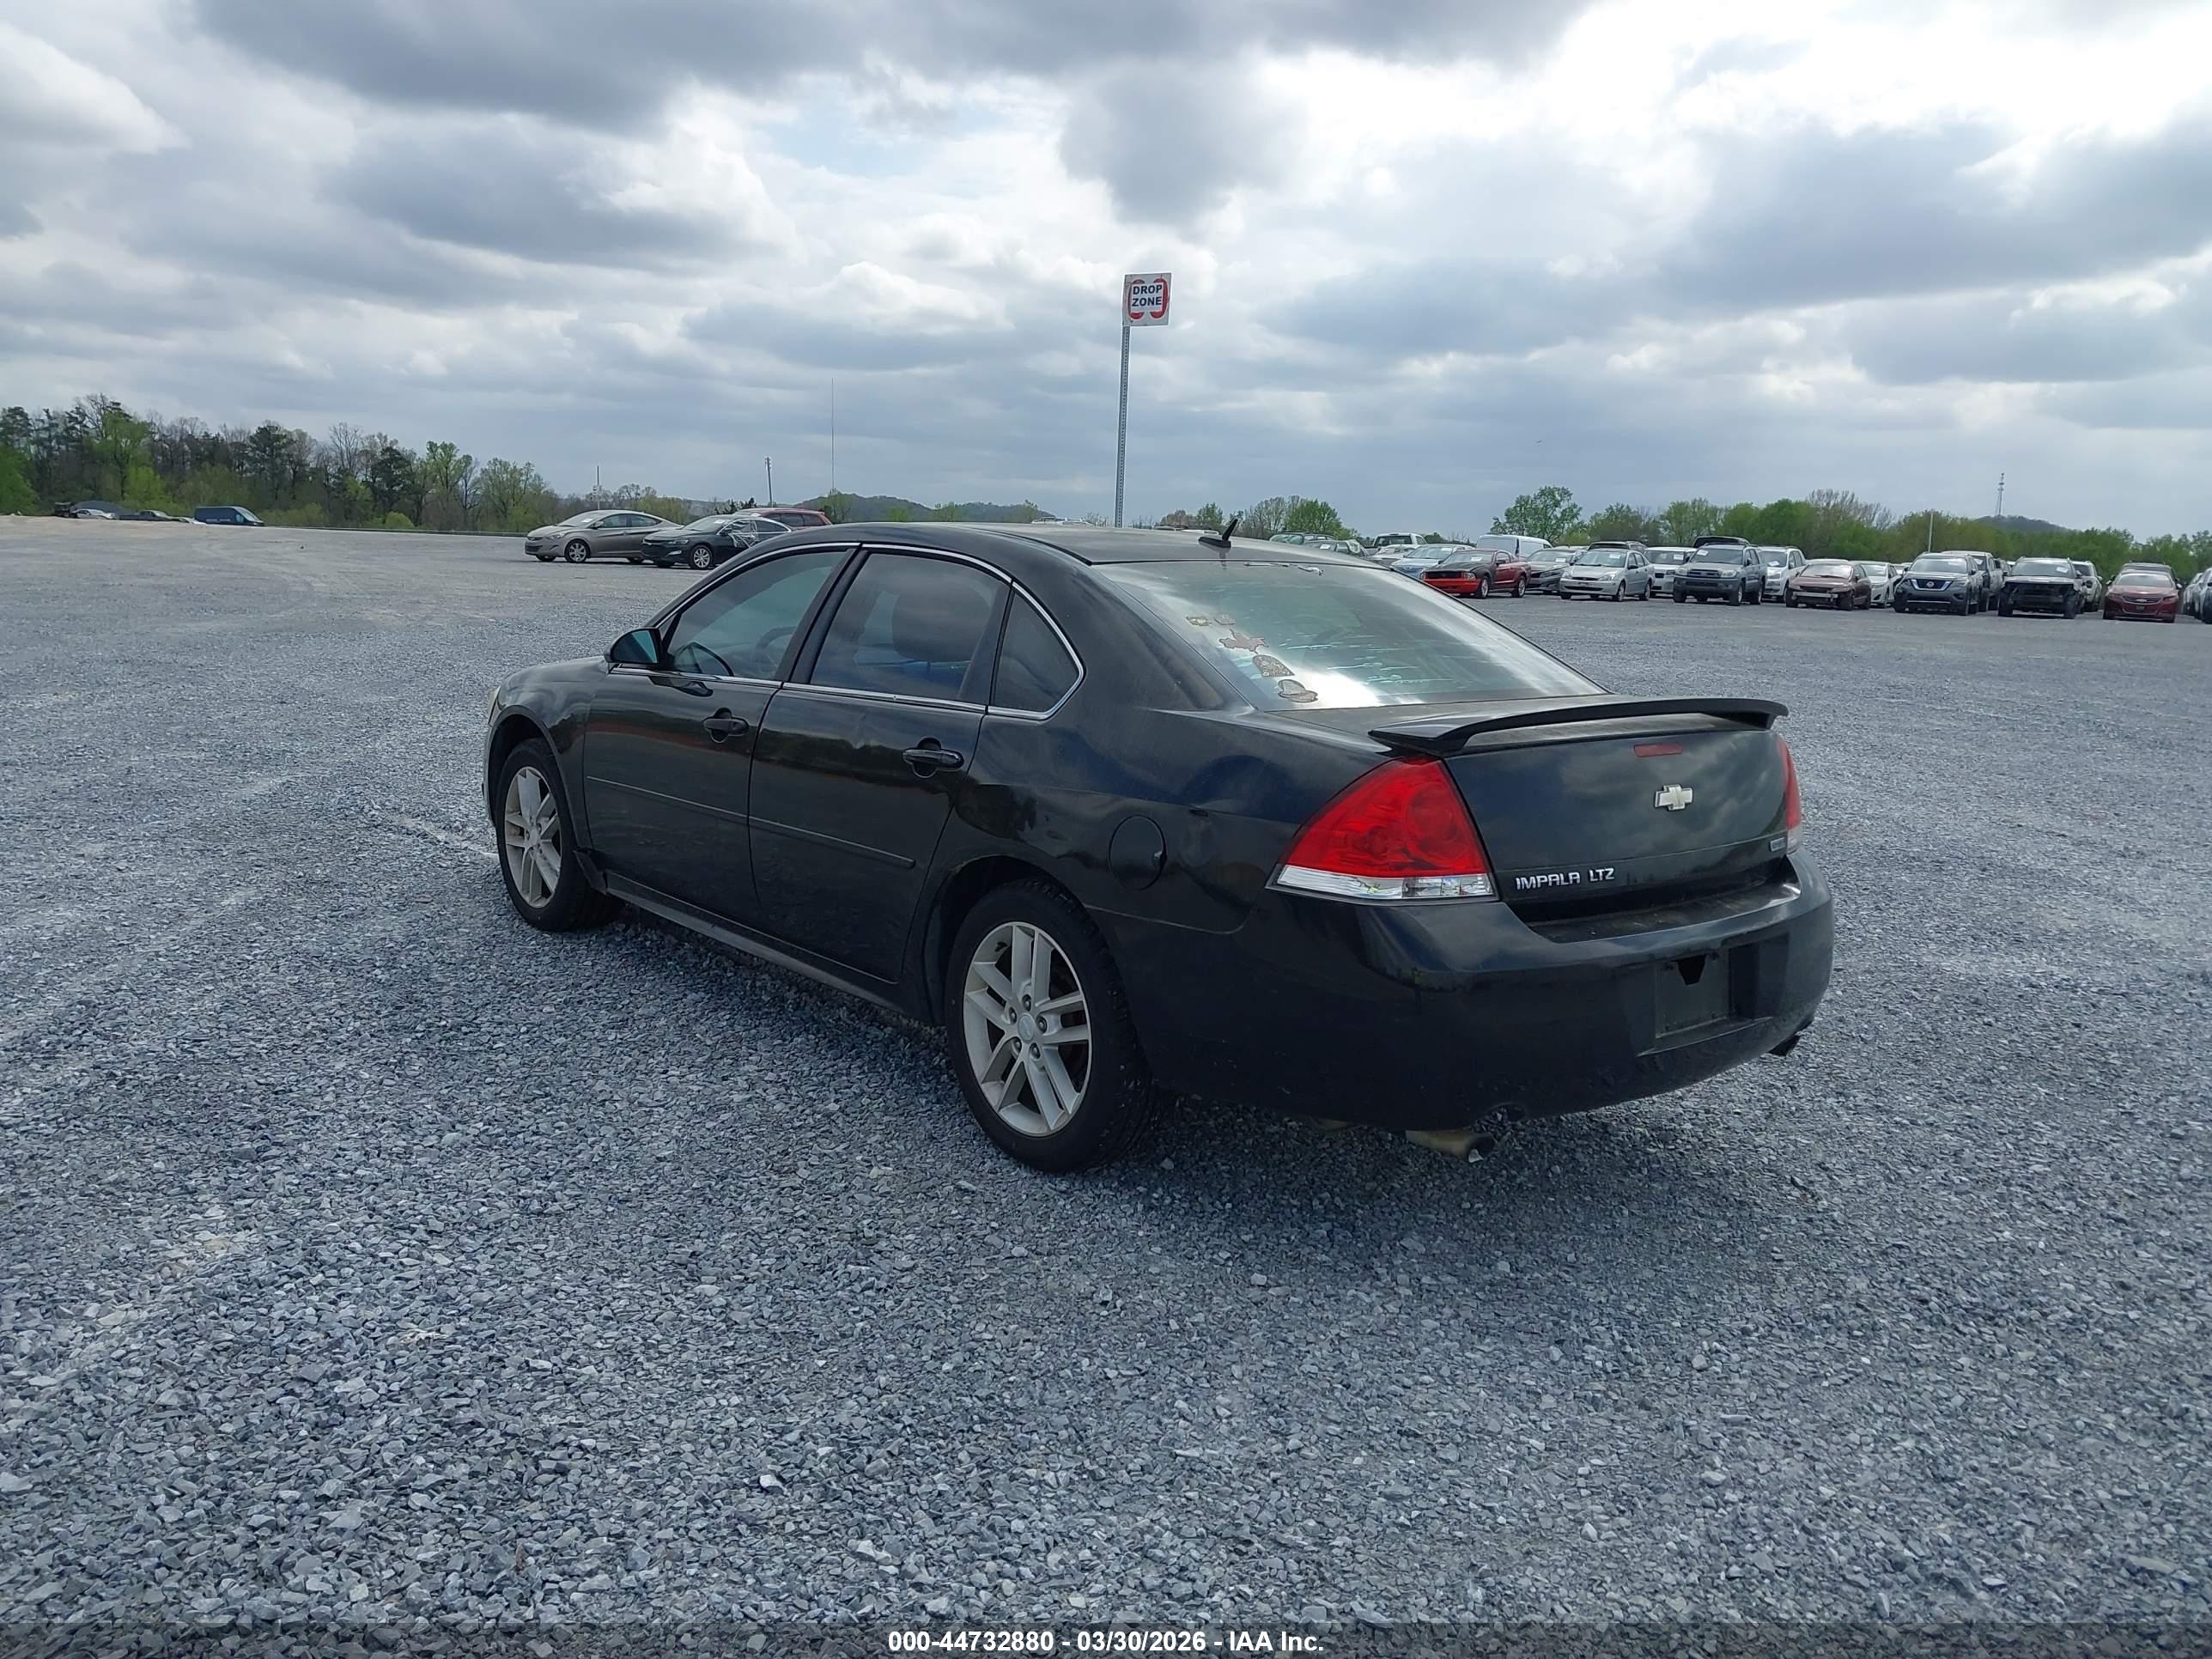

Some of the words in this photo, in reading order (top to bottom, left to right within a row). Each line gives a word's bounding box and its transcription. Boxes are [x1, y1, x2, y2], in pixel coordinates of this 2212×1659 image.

[1133, 284, 1162, 295] DROP
[1132, 296, 1162, 307] ZONE
[1516, 872, 1581, 890] IMPALA
[1589, 867, 1615, 882] LTZ
